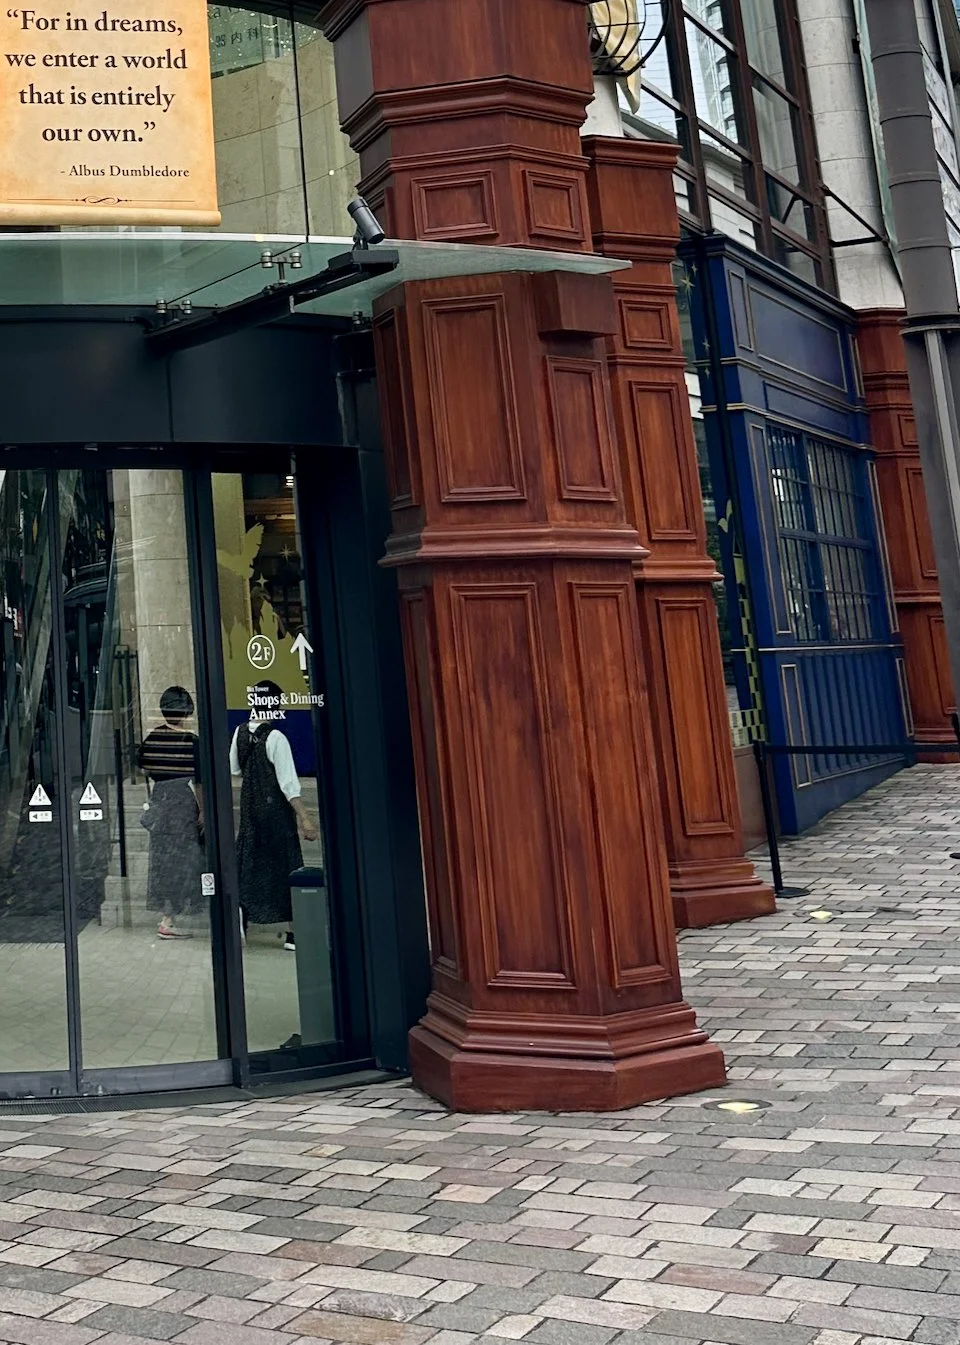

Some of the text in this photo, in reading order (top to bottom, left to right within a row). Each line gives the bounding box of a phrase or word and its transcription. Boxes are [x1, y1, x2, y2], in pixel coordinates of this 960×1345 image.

[6, 8, 60, 31] “For
[65, 11, 89, 32] in
[94, 10, 183, 36] dreams,
[5, 48, 189, 70] we enter a world
[18, 82, 177, 113] that is entirely
[41, 121, 156, 143] our own.”
[69, 164, 106, 177] Albus
[109, 164, 190, 178] Dumbledore
[251, 641, 271, 661] 2F
[247, 691, 324, 708] Shops & Dining
[249, 708, 286, 721] Annex
